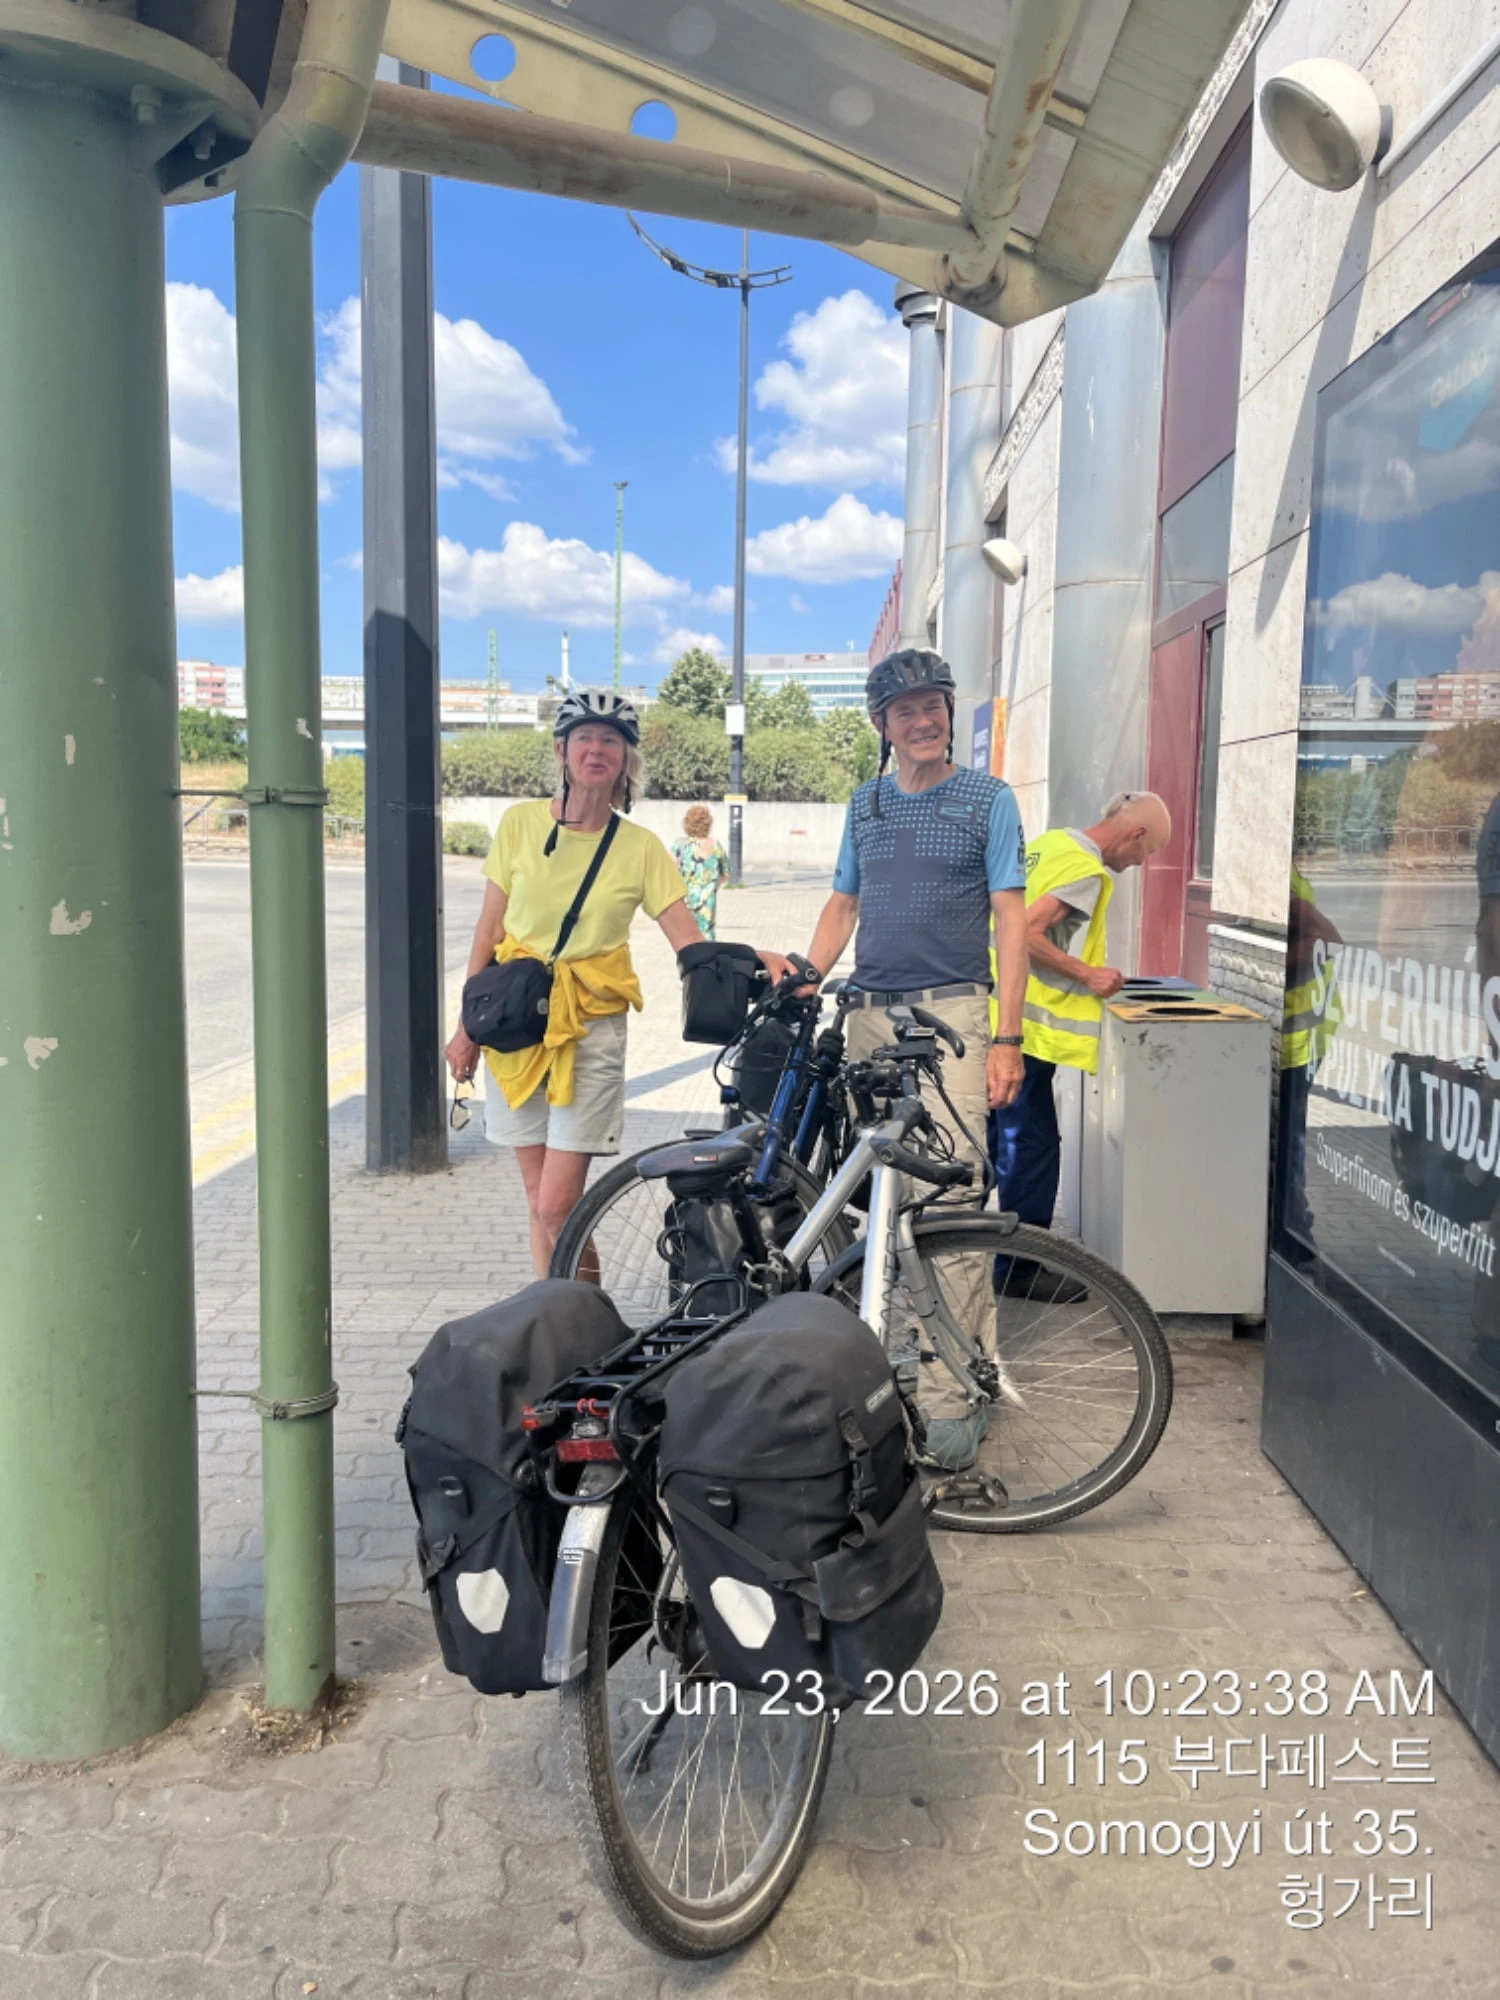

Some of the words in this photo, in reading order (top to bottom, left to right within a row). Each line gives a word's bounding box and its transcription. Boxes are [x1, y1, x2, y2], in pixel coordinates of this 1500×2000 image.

[1305, 1027, 1317, 1082] A
[1323, 1033, 1413, 1132] PULYKA
[1420, 1071, 1500, 1178] TUDJ
[1316, 1132, 1392, 1209] Szuperfinom
[1394, 1180, 1410, 1222] és
[1412, 1200, 1496, 1277] szuperfitt
